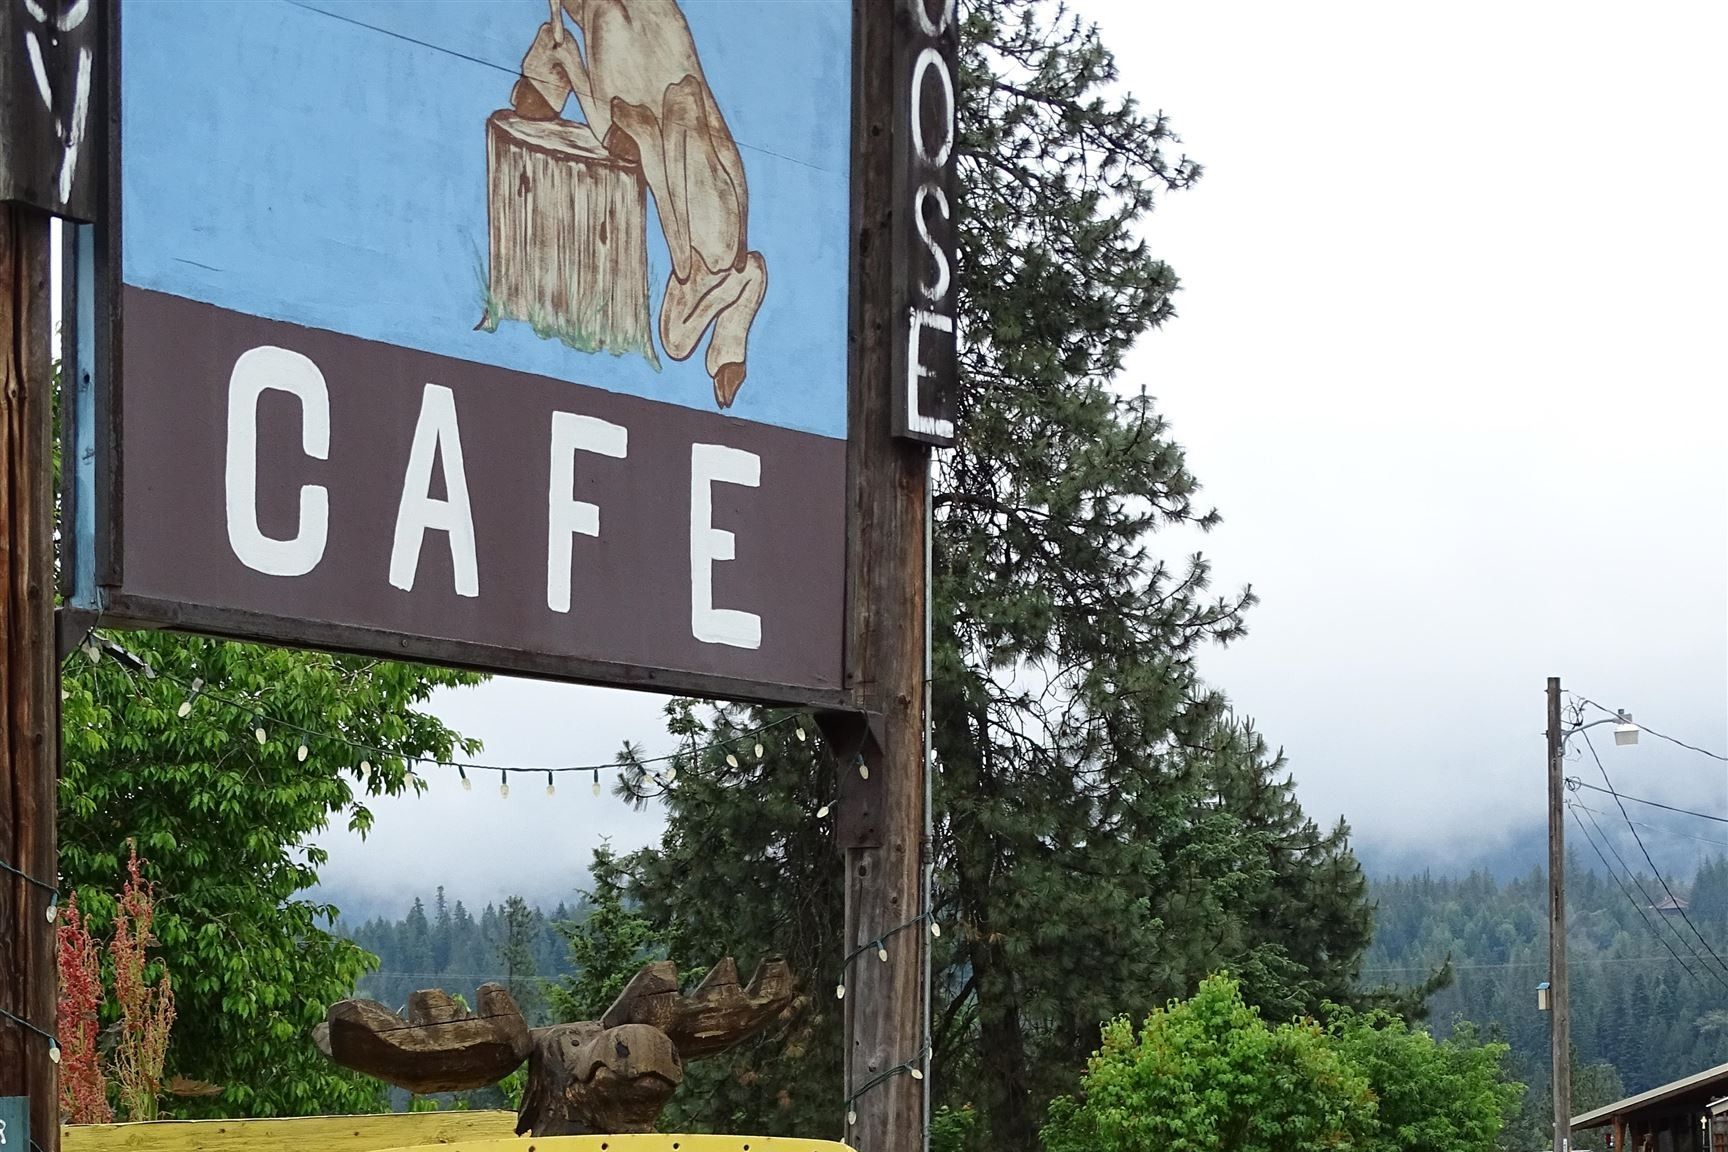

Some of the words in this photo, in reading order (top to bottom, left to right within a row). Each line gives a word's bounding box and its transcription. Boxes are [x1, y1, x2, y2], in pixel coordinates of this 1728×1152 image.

[24, 0, 93, 205] Y
[908, 0, 955, 438] OSE
[226, 345, 762, 650] CAFE
